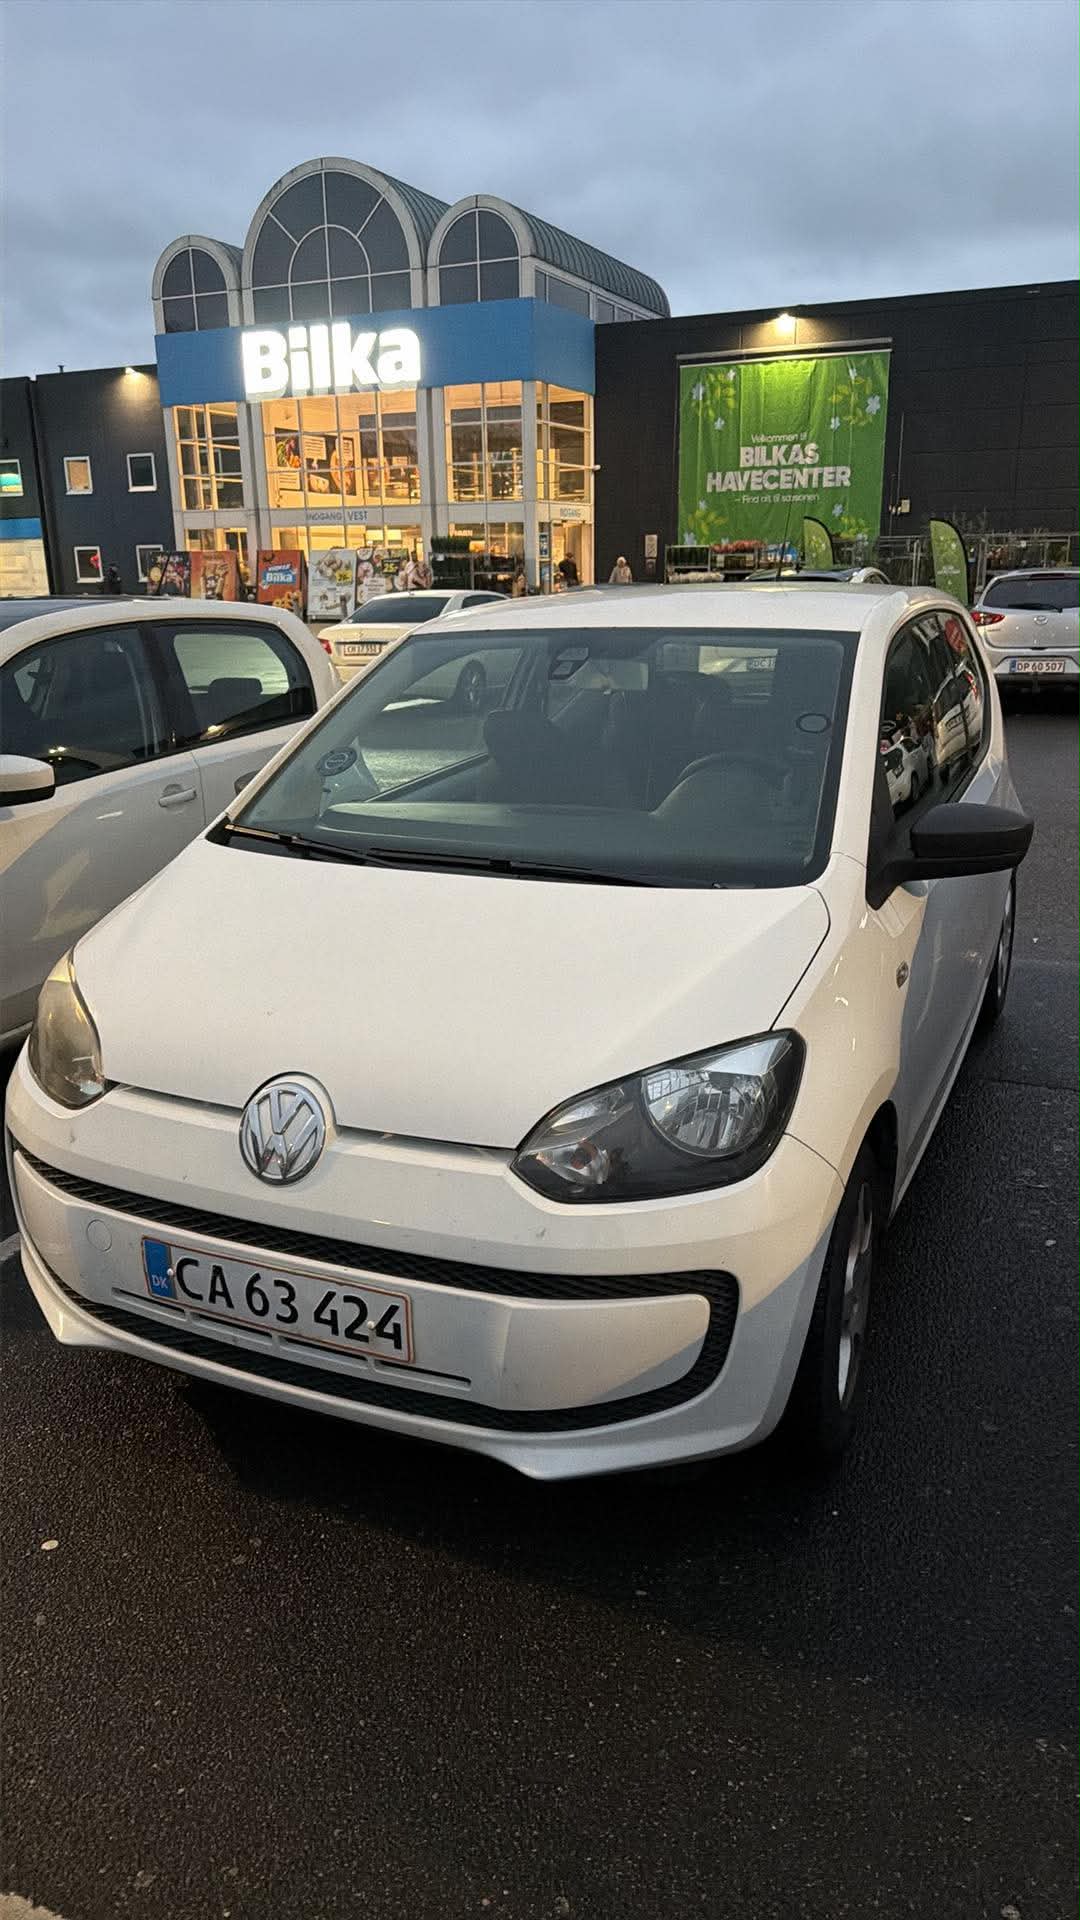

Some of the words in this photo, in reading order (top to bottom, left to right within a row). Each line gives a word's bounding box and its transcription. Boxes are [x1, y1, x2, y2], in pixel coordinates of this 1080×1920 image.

[241, 321, 422, 402] Bilka
[740, 443, 819, 467] BILKAS
[706, 466, 851, 493] HAVECENTER
[742, 495, 760, 504] Find
[347, 511, 368, 520] VEST
[266, 571, 294, 582] Bilka
[1016, 662, 1030, 671] DP
[1031, 662, 1044, 671] 60
[1044, 662, 1063, 671] 507
[246, 1086, 320, 1179] VW
[152, 1274, 168, 1289] DK
[176, 1257, 234, 1309] CA
[245, 1272, 299, 1324] 63
[313, 1290, 402, 1350] 424
